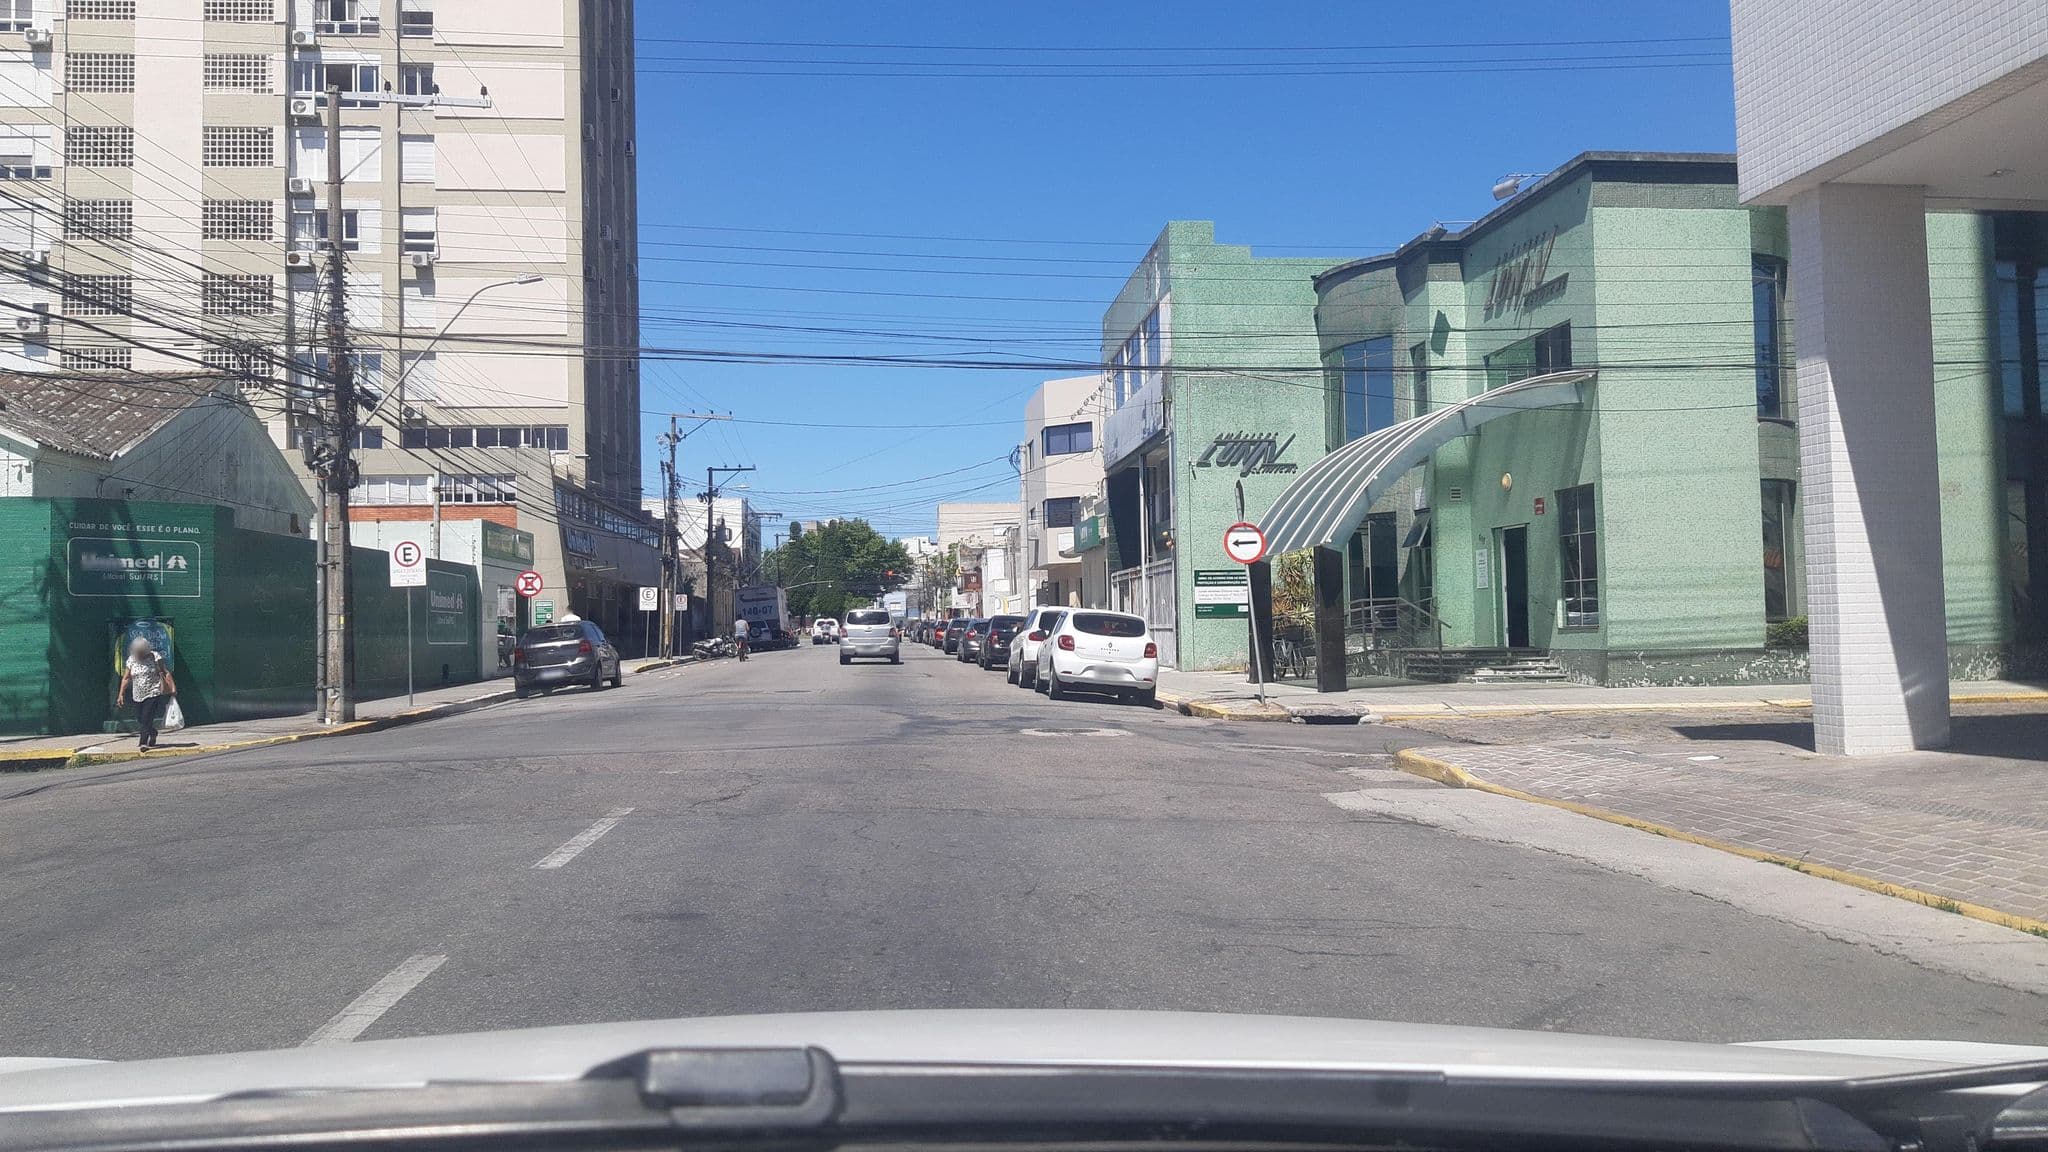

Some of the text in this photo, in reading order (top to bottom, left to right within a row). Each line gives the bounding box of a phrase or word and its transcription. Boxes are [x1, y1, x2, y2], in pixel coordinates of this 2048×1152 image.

[69, 522, 96, 530] CUIDAR
[158, 524, 164, 532] É
[82, 553, 159, 569] med
[402, 547, 413, 562] E
[430, 589, 456, 609] Unimed
